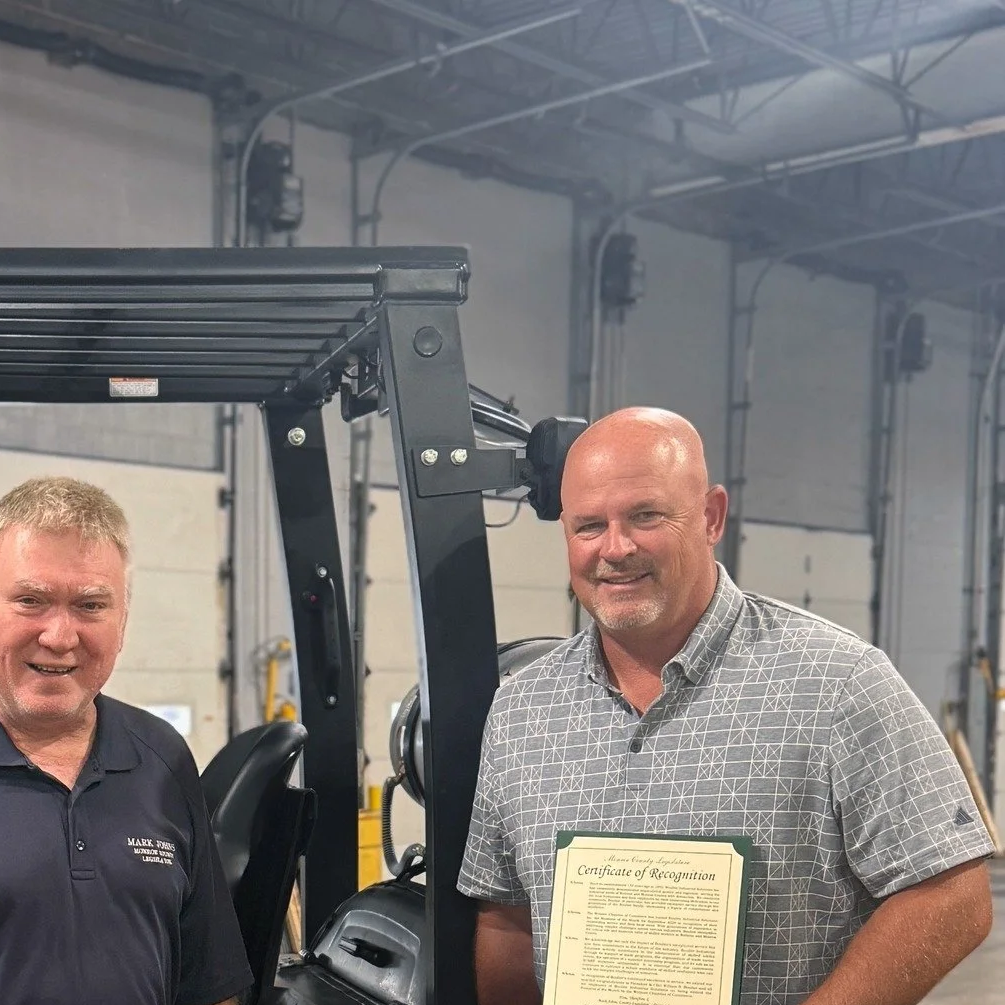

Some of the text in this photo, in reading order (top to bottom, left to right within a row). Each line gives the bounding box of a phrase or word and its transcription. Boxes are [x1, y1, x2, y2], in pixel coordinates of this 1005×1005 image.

[128, 837, 153, 847] MARK
[577, 864, 716, 883] Certificate of Recognition
